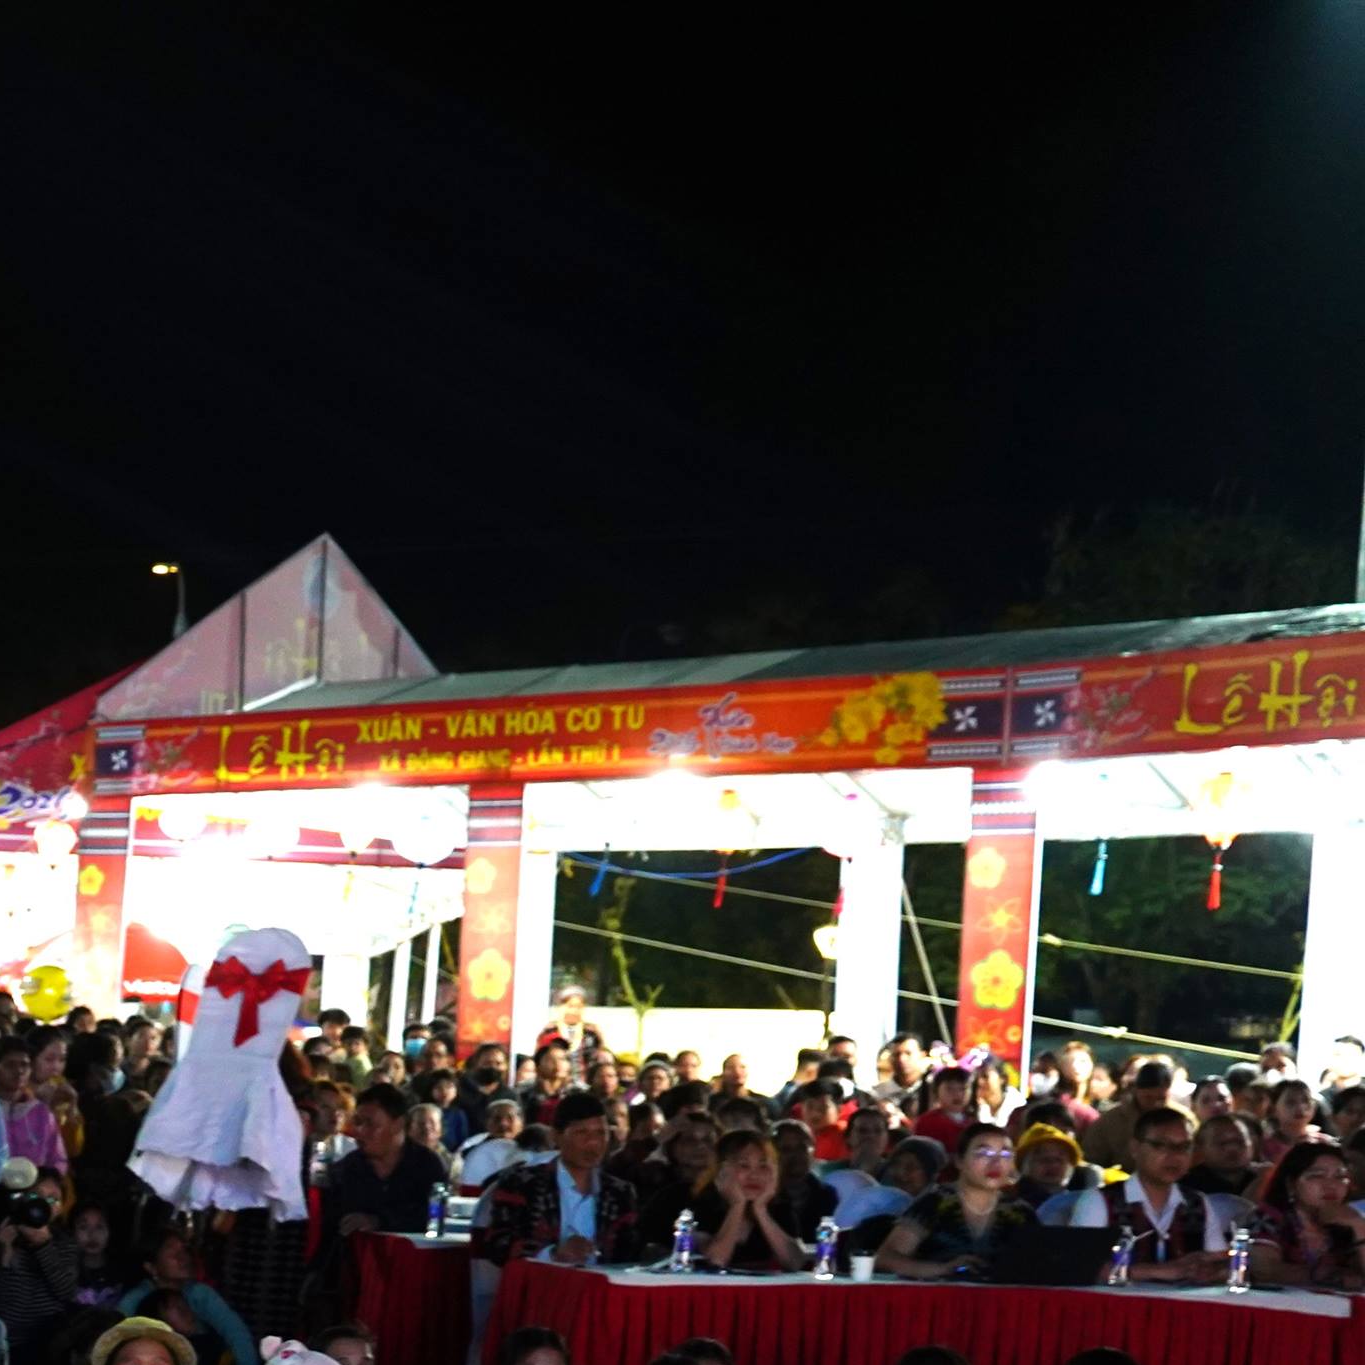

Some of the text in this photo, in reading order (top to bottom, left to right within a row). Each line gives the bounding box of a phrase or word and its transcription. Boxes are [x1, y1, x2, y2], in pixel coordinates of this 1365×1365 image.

[356, 711, 422, 744] XUÂN
[445, 709, 497, 739] VĂN
[504, 702, 557, 736] HÓA
[565, 703, 603, 733] CƠ
[610, 704, 646, 731] TU
[1175, 649, 1358, 735] Lễ Hội
[215, 718, 346, 783] Lễ Hội
